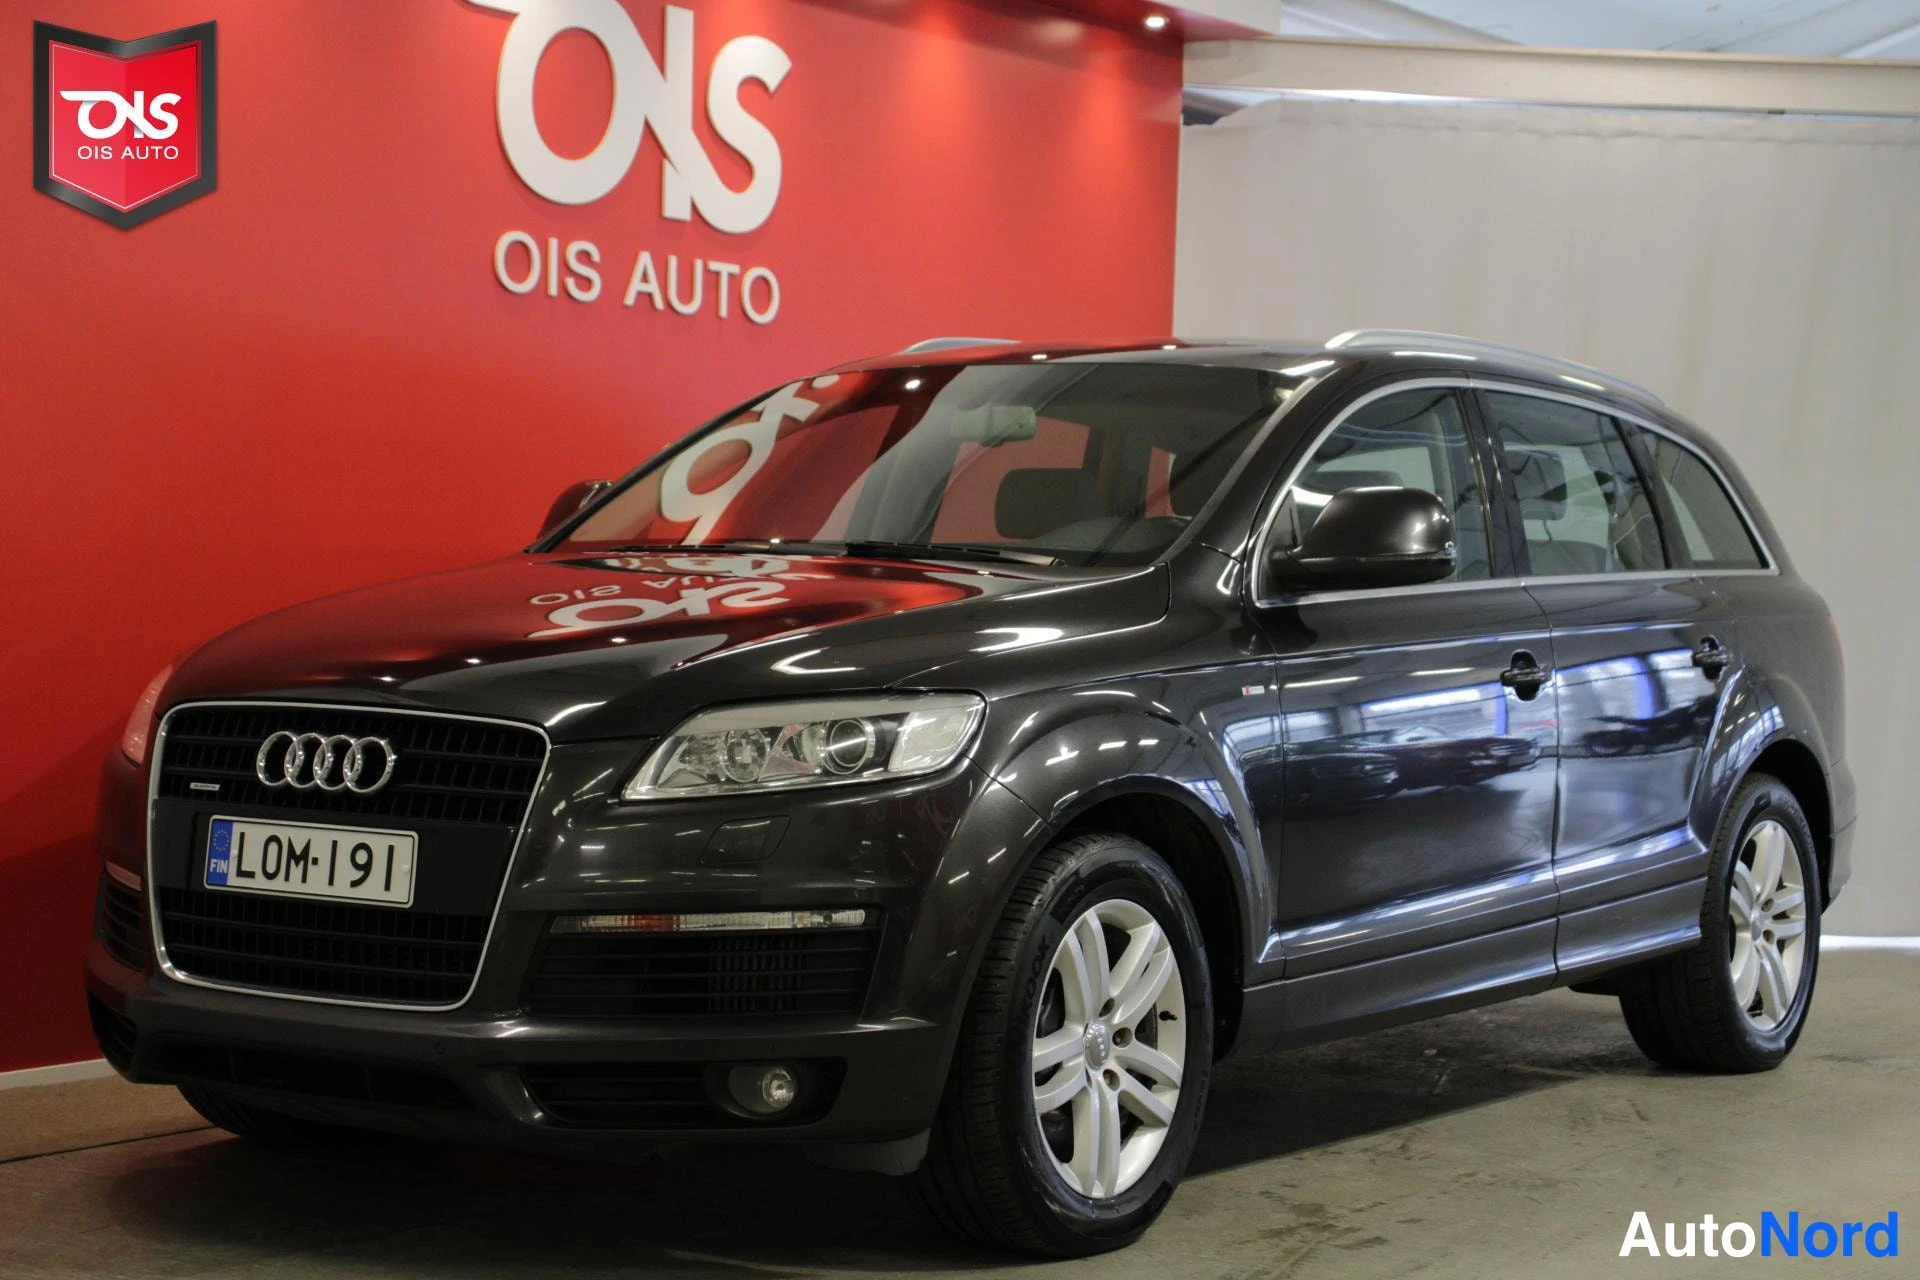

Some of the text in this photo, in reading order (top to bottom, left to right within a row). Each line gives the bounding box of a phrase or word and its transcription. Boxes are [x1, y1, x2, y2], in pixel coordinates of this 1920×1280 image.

[464, 0, 793, 234] OIS
[493, 230, 781, 324] OIS AUTO
[209, 858, 229, 874] FIN
[235, 831, 395, 892] LOM-191
